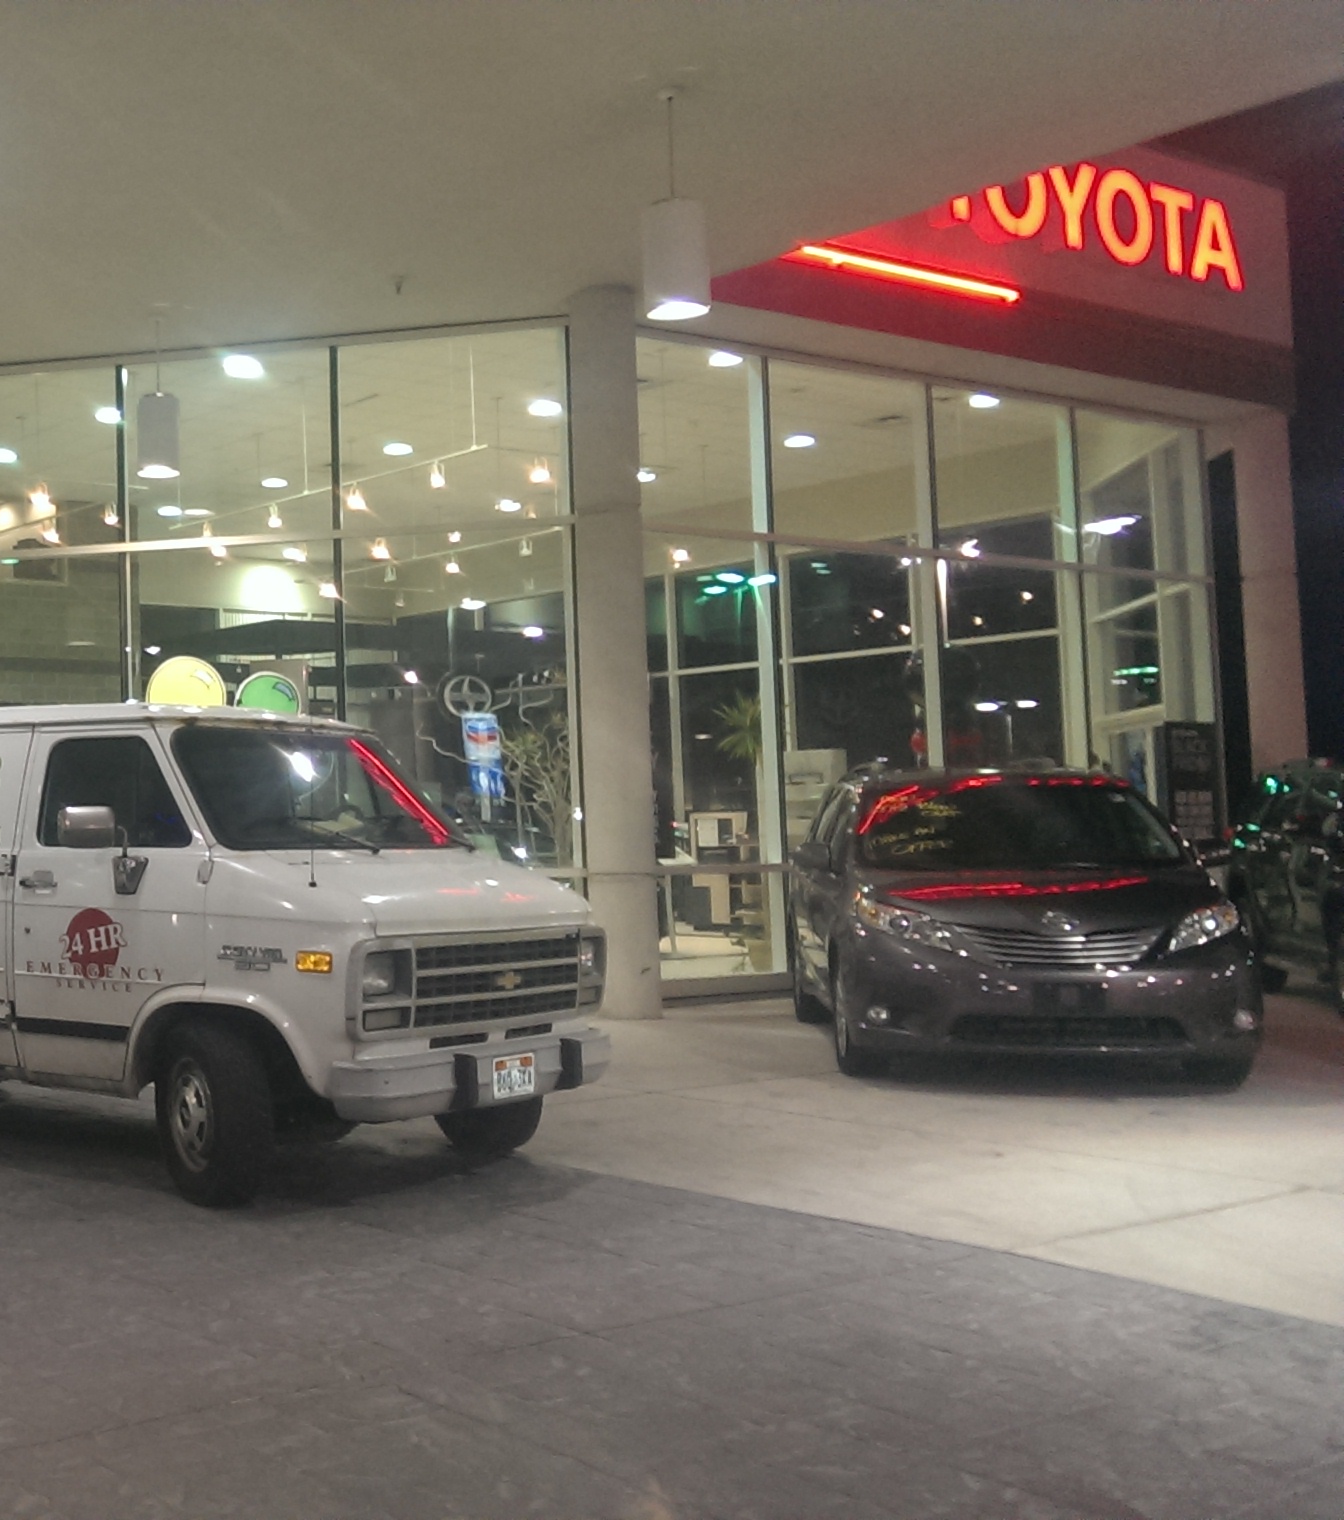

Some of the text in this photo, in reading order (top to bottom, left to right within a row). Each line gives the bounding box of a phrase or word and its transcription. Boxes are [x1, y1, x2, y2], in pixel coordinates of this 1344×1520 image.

[952, 162, 1244, 291] OYOTA
[60, 922, 127, 960] 24 HR
[26, 961, 165, 982] EMERGENCY
[57, 980, 133, 993] SERVICE
